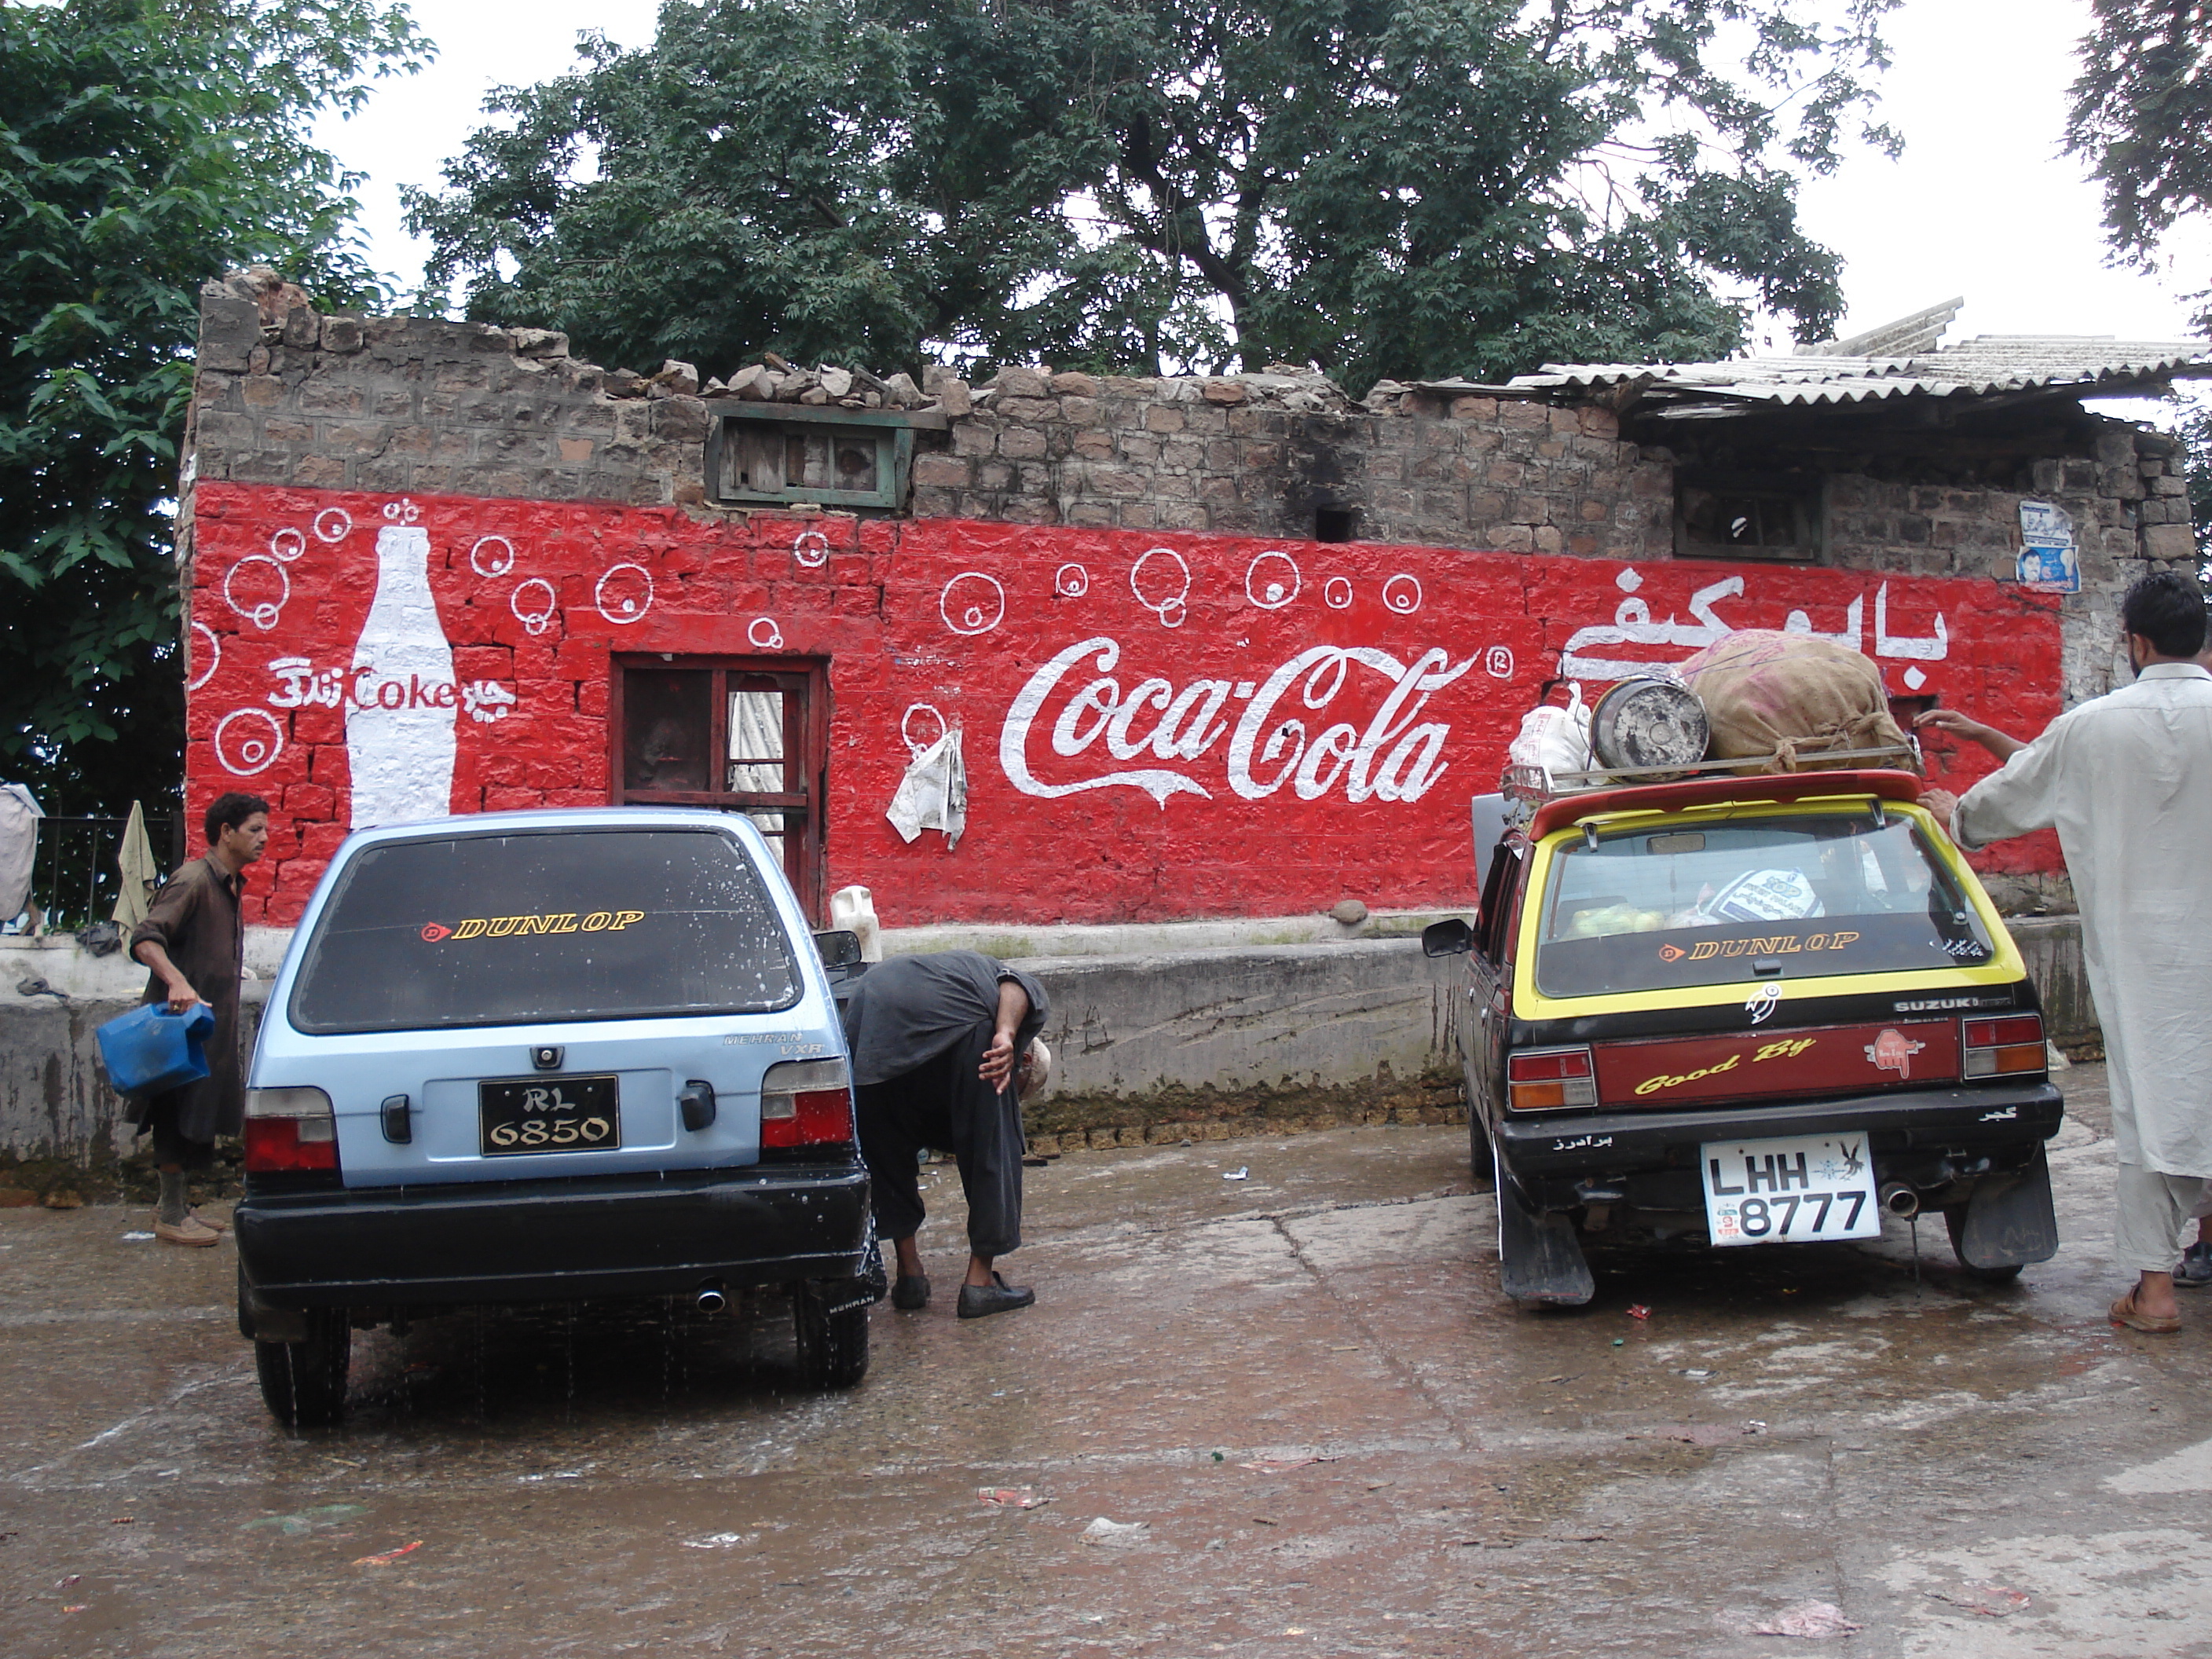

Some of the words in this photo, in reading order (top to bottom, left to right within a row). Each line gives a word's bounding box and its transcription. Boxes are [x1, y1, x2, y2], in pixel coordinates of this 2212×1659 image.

[350, 666, 458, 710] Coke
[999, 636, 1482, 811] Coca-Cola
[450, 910, 645, 940] DUNLOP
[1688, 932, 1860, 960] DUNLOP
[1895, 998, 1979, 1013] SUZUKI
[723, 1032, 803, 1046] MEHRAN
[780, 1043, 823, 1057] VXR
[1635, 1054, 1741, 1095] Good
[1752, 1038, 1817, 1062] By
[522, 1087, 577, 1112] RL
[490, 1117, 610, 1146] 6850
[1710, 1152, 1809, 1196] LHH
[1739, 1191, 1866, 1237] 8777
[830, 1295, 874, 1314] MEHRAN
